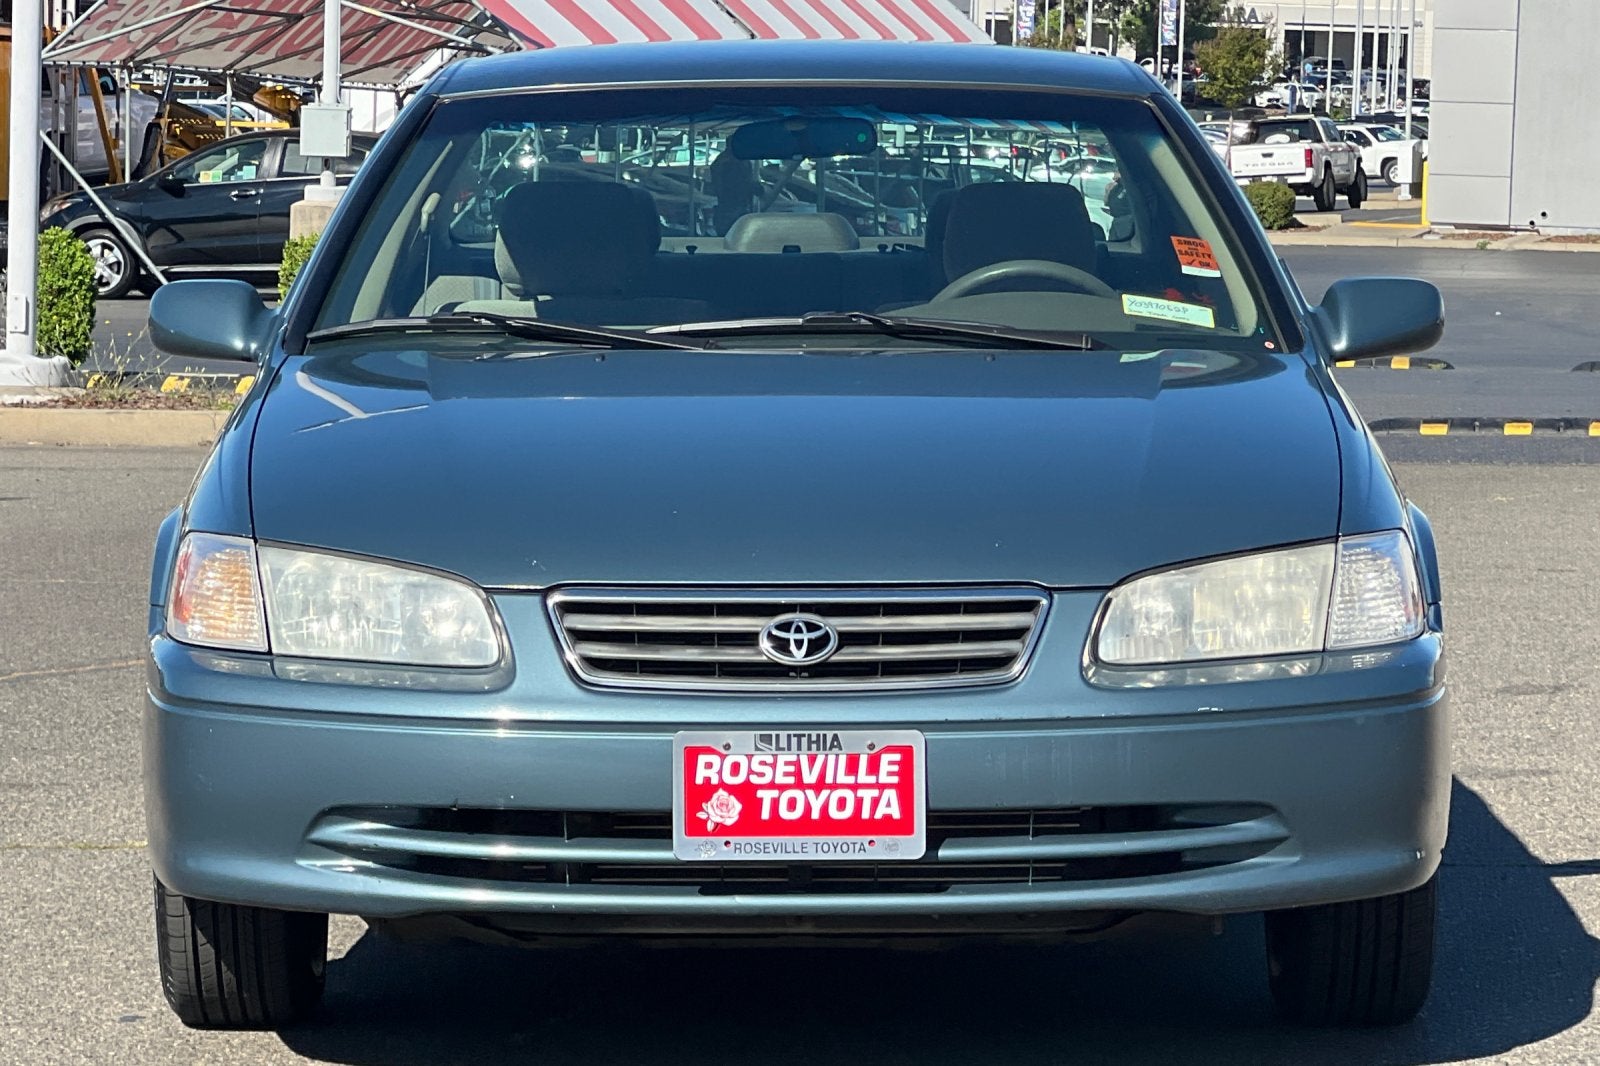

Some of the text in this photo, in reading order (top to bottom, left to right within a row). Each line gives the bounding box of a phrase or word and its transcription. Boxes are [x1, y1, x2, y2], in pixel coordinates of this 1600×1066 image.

[1177, 239, 1205, 249] SMOG
[1178, 249, 1212, 259] SAFETY
[775, 733, 843, 751] LITHIA
[695, 753, 902, 785] ROSEVILLE
[756, 788, 901, 820] TOYOTA
[733, 841, 867, 854] ROSEVILLE TOYOTA
